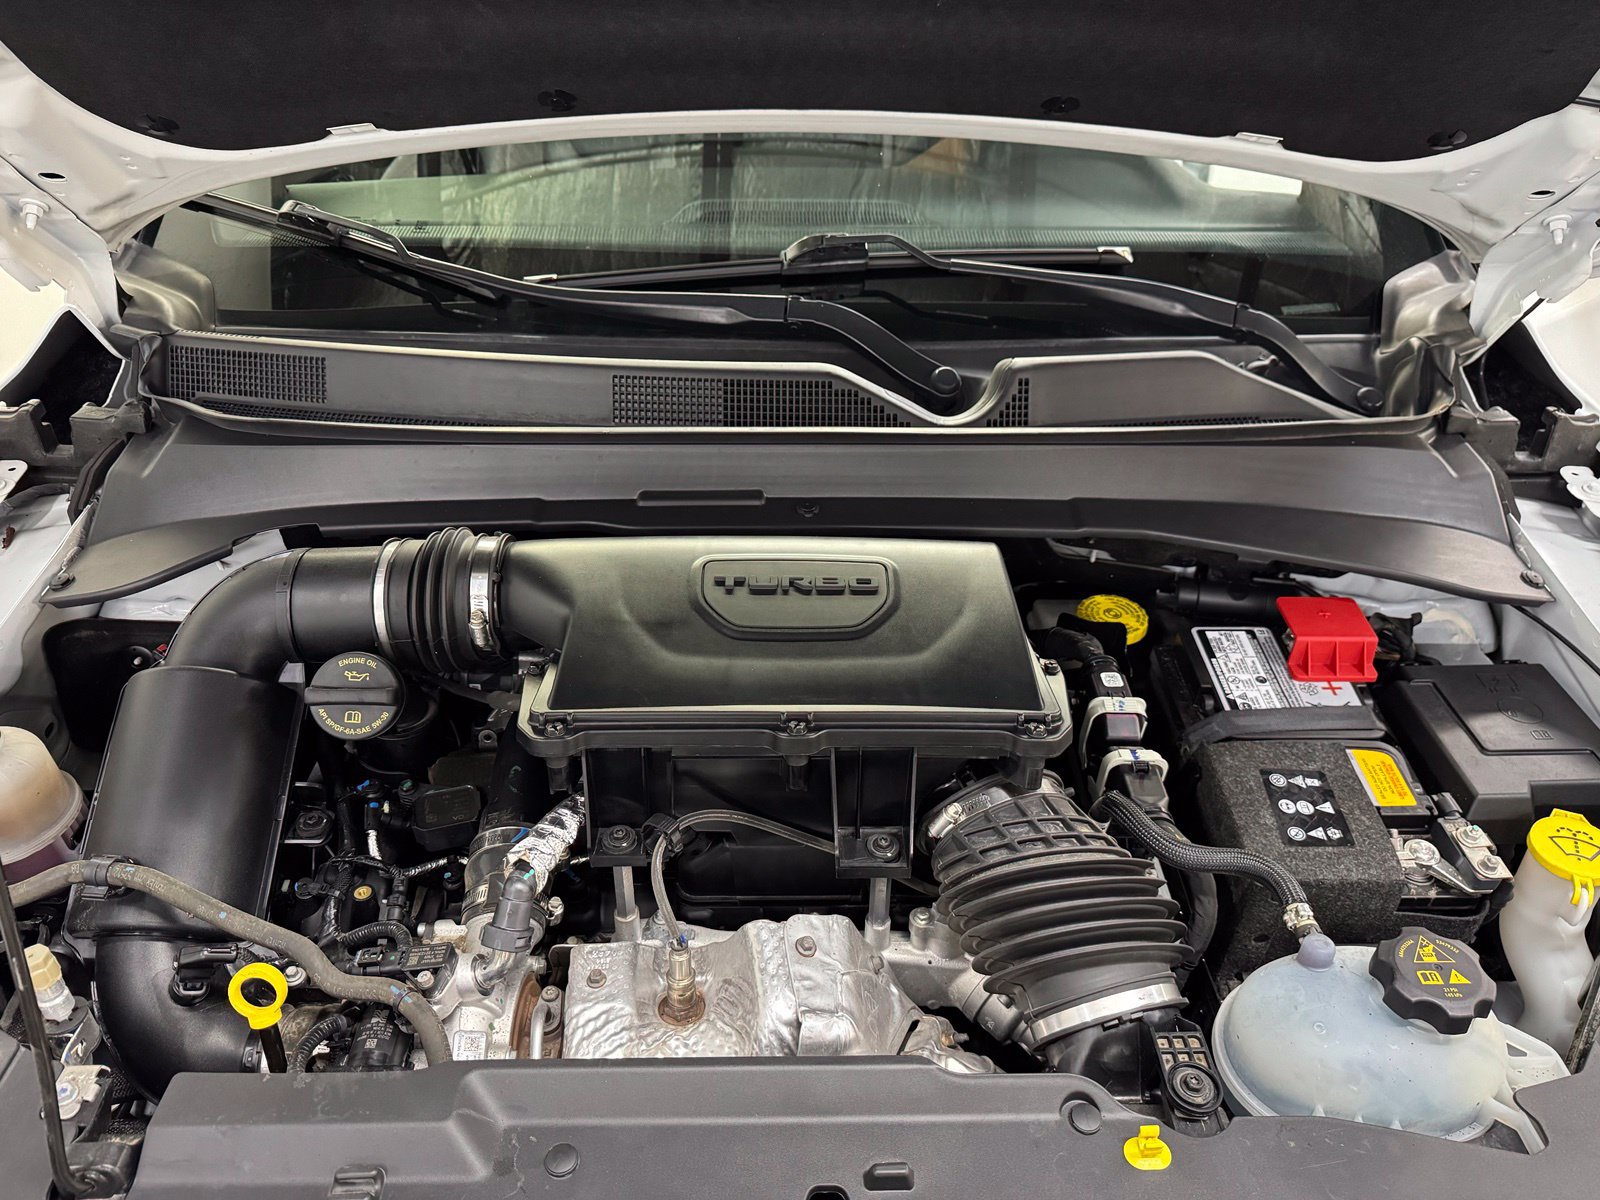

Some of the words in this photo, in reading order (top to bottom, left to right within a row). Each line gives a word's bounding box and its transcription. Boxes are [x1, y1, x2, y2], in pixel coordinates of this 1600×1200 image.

[713, 575, 879, 595] TURBO
[337, 657, 366, 667] ENGINE
[366, 659, 377, 669] OIL
[318, 708, 326, 720] API
[371, 711, 389, 729] 5W-30
